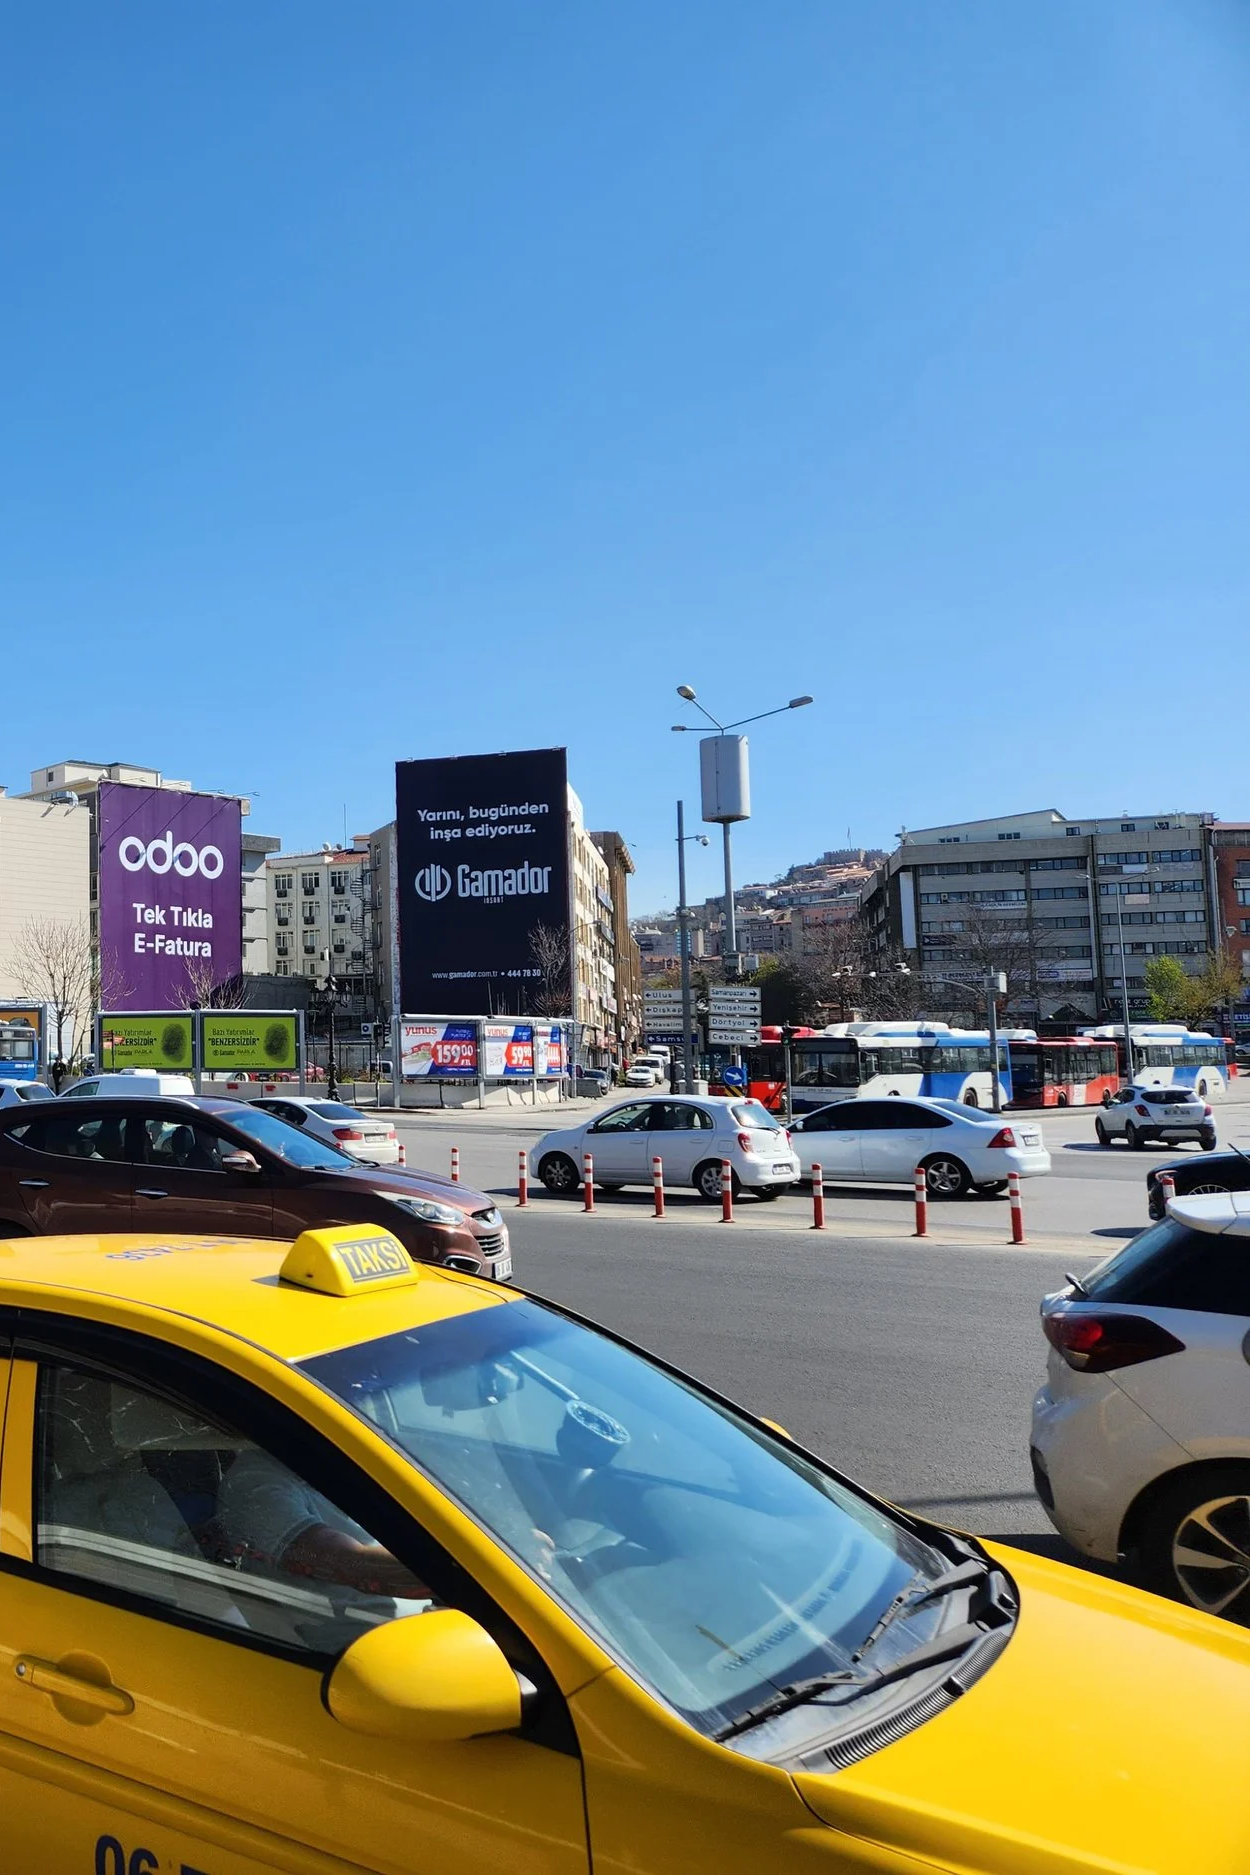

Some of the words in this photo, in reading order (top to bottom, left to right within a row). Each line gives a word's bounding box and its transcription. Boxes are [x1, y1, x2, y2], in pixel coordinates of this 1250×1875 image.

[417, 809, 465, 822] Yarını,
[469, 802, 549, 820] bugünden
[430, 826, 462, 841] inşa
[465, 823, 536, 839] ediyoruz.
[118, 830, 224, 880] odoo
[457, 860, 552, 897] Gamador
[132, 903, 166, 925] Tek
[170, 906, 213, 928] Tıkla
[134, 933, 212, 957] E-Fatura
[432, 970, 498, 980] www.gamador.com.tr
[507, 970, 521, 978] 444
[532, 969, 541, 977] 30
[405, 1025, 437, 1036] yunus
[712, 1018, 745, 1026] Dörtyol
[487, 1026, 510, 1038] yunus
[712, 1033, 744, 1041] Cebeci
